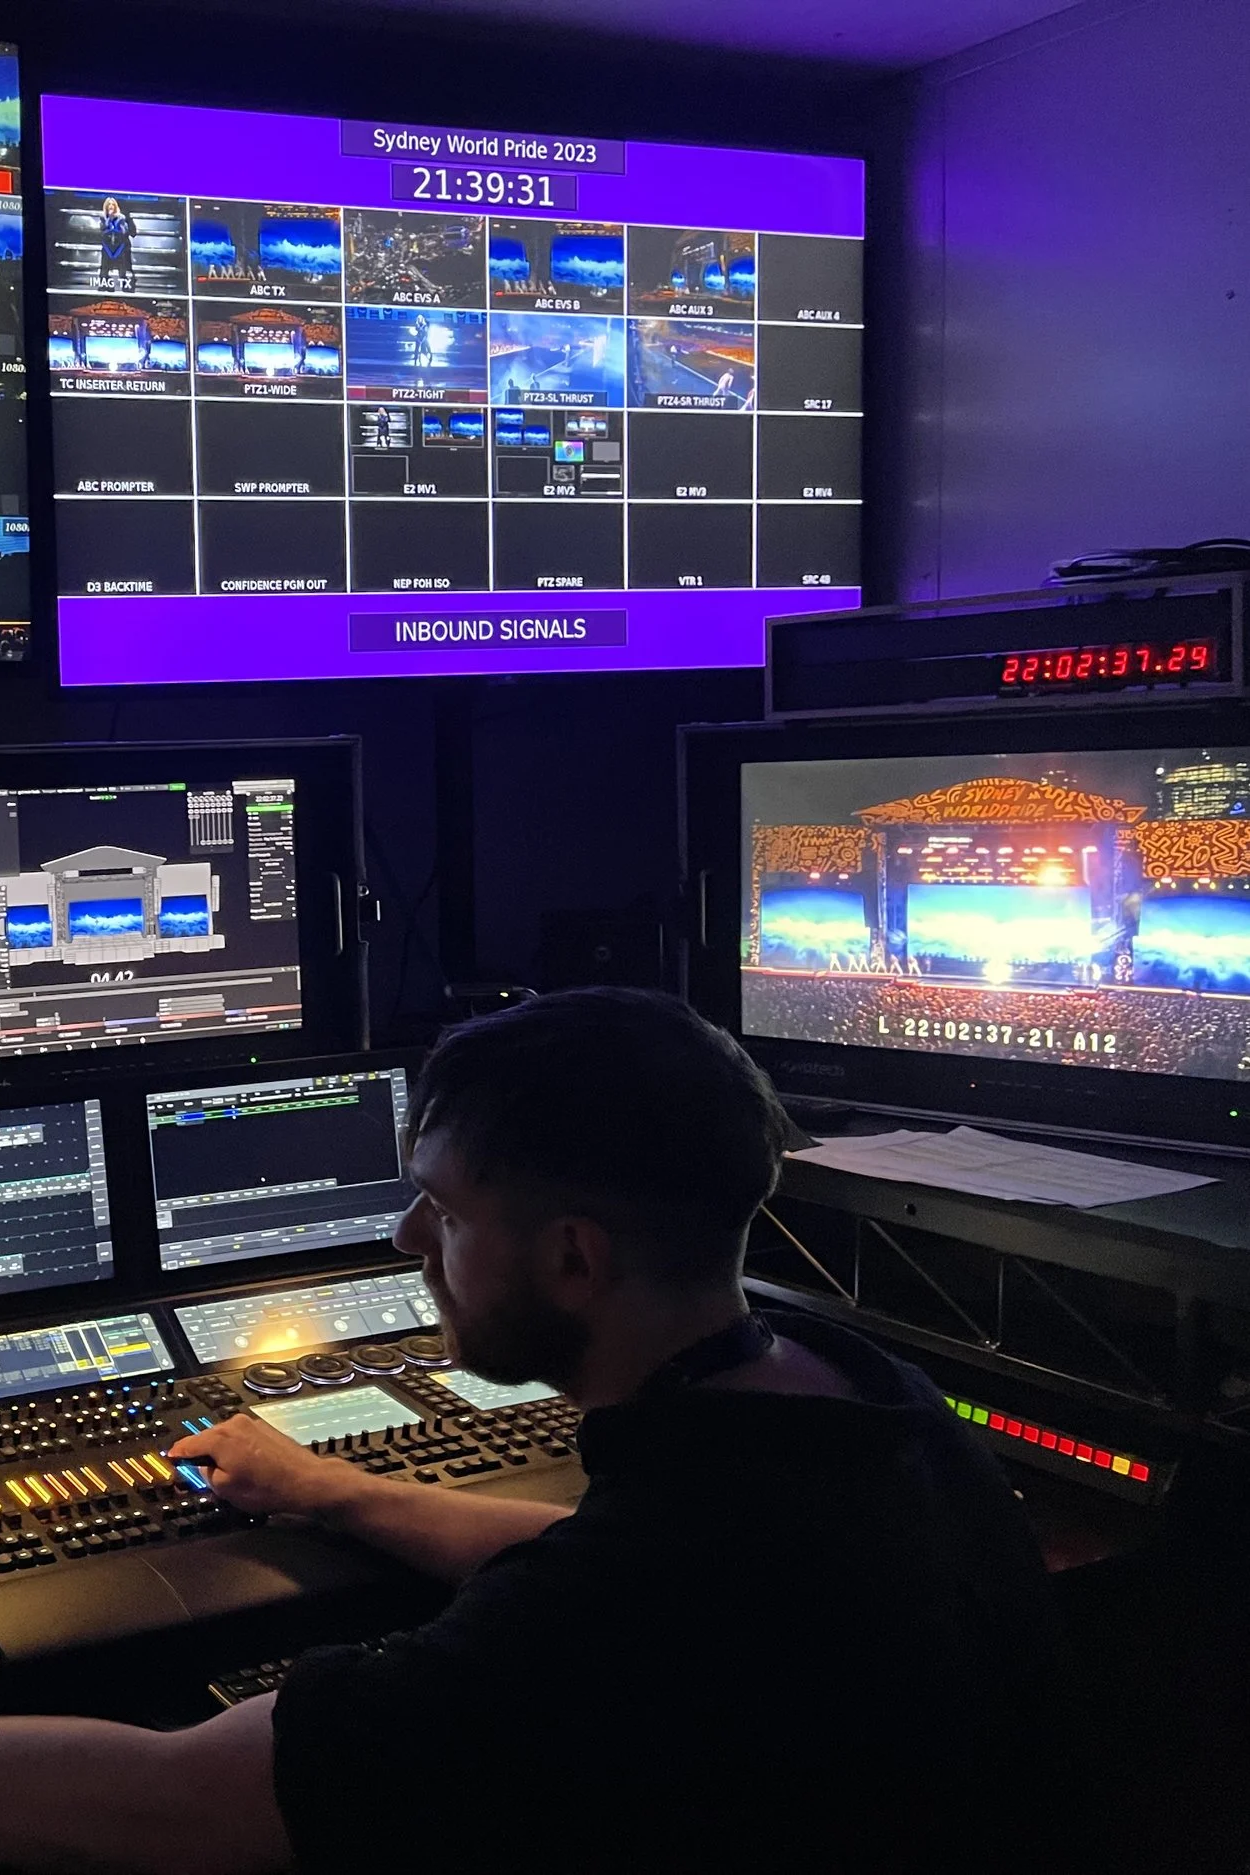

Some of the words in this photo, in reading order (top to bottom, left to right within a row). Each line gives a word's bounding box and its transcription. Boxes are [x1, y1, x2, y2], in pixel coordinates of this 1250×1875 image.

[373, 128, 442, 156] Sydney
[447, 135, 498, 156] World
[505, 138, 548, 160] Pride
[553, 142, 597, 163] 2023
[413, 166, 554, 207] 21:39:31
[89, 276, 115, 289] IMAG
[118, 277, 132, 290] TX
[250, 285, 272, 296] ABC
[273, 286, 286, 297] TX
[393, 291, 413, 302] ABC
[414, 292, 432, 303] EVS
[433, 293, 441, 304] A
[535, 298, 554, 309] ABC
[556, 299, 573, 310] EVS
[574, 300, 581, 310] B
[669, 304, 688, 315] ABC
[689, 305, 706, 316] AUX
[707, 306, 714, 316] 3
[798, 309, 816, 320] ABC
[816, 310, 833, 321] AUX
[834, 310, 840, 321] 4
[60, 379, 74, 389] TC
[76, 379, 124, 391] INSERTER
[126, 381, 166, 392] RETURN
[244, 384, 297, 396] PTZ1-WIDE
[392, 389, 445, 400] PTZ2-TIGHT
[523, 392, 559, 403] PTZ3-SL
[561, 393, 594, 404] THRUST
[657, 396, 691, 407] PTZ4-SR
[693, 396, 725, 408] THRUST
[803, 399, 820, 410] SRC
[821, 399, 832, 410] 17
[77, 481, 98, 492] ABC
[101, 481, 155, 493] PROMPTER
[234, 482, 257, 493] SWP
[259, 483, 310, 494] PROMPTER
[403, 484, 416, 495] E2
[417, 484, 437, 495] MV1
[543, 485, 556, 496] E2
[556, 485, 576, 497] MV2
[676, 486, 688, 497] E2
[689, 486, 707, 497] MV3
[803, 487, 814, 498] E2
[815, 487, 832, 498] MV4
[87, 582, 102, 593] D3
[104, 581, 153, 592] BACKTIME
[221, 580, 281, 592] CONFIDENCE
[283, 580, 304, 590] PGM
[305, 580, 327, 590] OUT
[393, 578, 411, 589] NEP
[413, 578, 431, 589] FOH
[432, 578, 450, 588] ISO
[537, 577, 554, 588] PTZ
[555, 576, 584, 587] SPARE
[679, 576, 695, 587] VTR
[696, 576, 703, 586] 1
[395, 620, 494, 642] INBOUND
[499, 618, 587, 640] SIGNALS
[1002, 645, 1207, 683] 22:02:37.29
[965, 784, 1026, 802] SYDNEY
[942, 803, 1047, 819] WORLDPRIDE
[878, 1016, 890, 1035] L
[1074, 1031, 1116, 1054] A12
